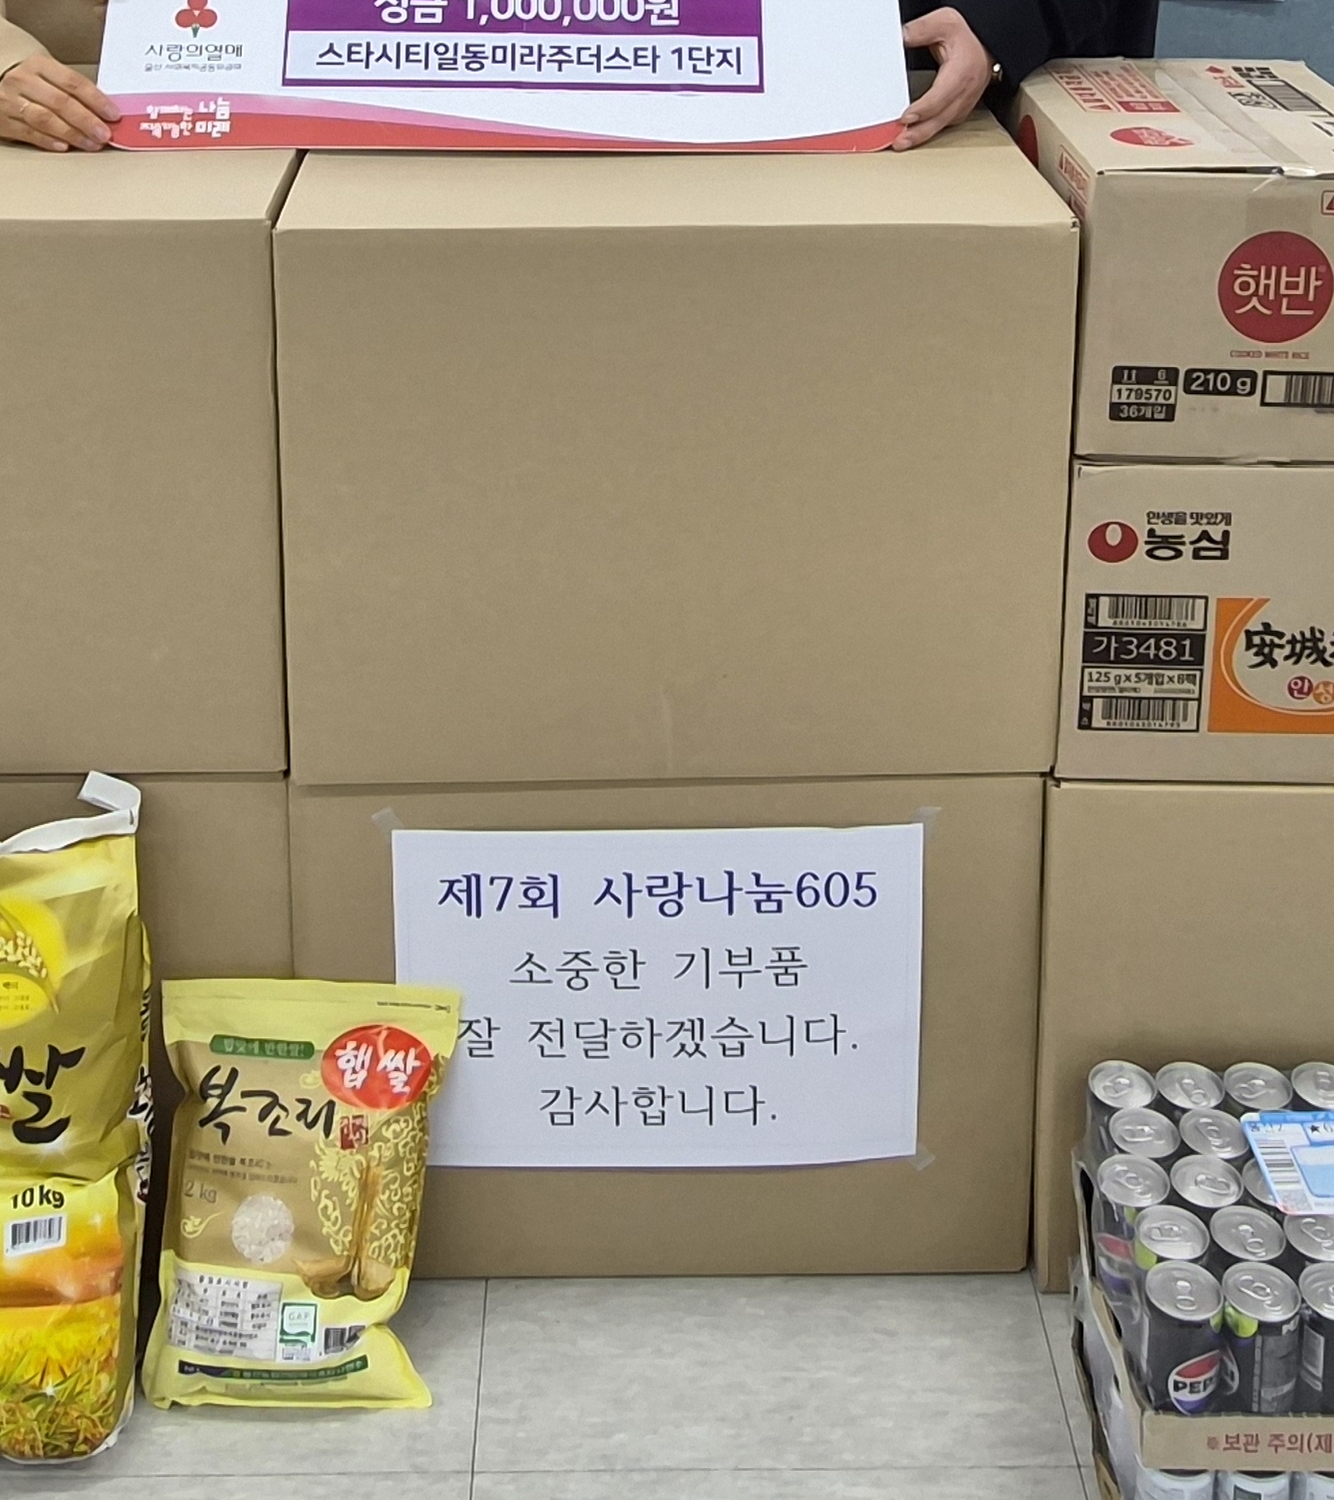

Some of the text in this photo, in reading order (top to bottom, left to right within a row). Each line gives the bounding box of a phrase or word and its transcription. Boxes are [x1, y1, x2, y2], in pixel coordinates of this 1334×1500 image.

[144, 43, 244, 63] 사랑의열매
[315, 42, 742, 76] 스타시티일동미라주더스타 1단지
[1232, 262, 1322, 316] 햇반
[1144, 527, 1231, 561] 농심
[1092, 635, 1195, 661] 가3481
[438, 869, 879, 920] 제7회 사랑나눔605
[509, 945, 809, 991] 소중한 기부품
[457, 1013, 860, 1060] 잘 전달하겠습니다.
[198, 1064, 337, 1146] 복조리
[539, 1084, 778, 1128] 감사합니다.
